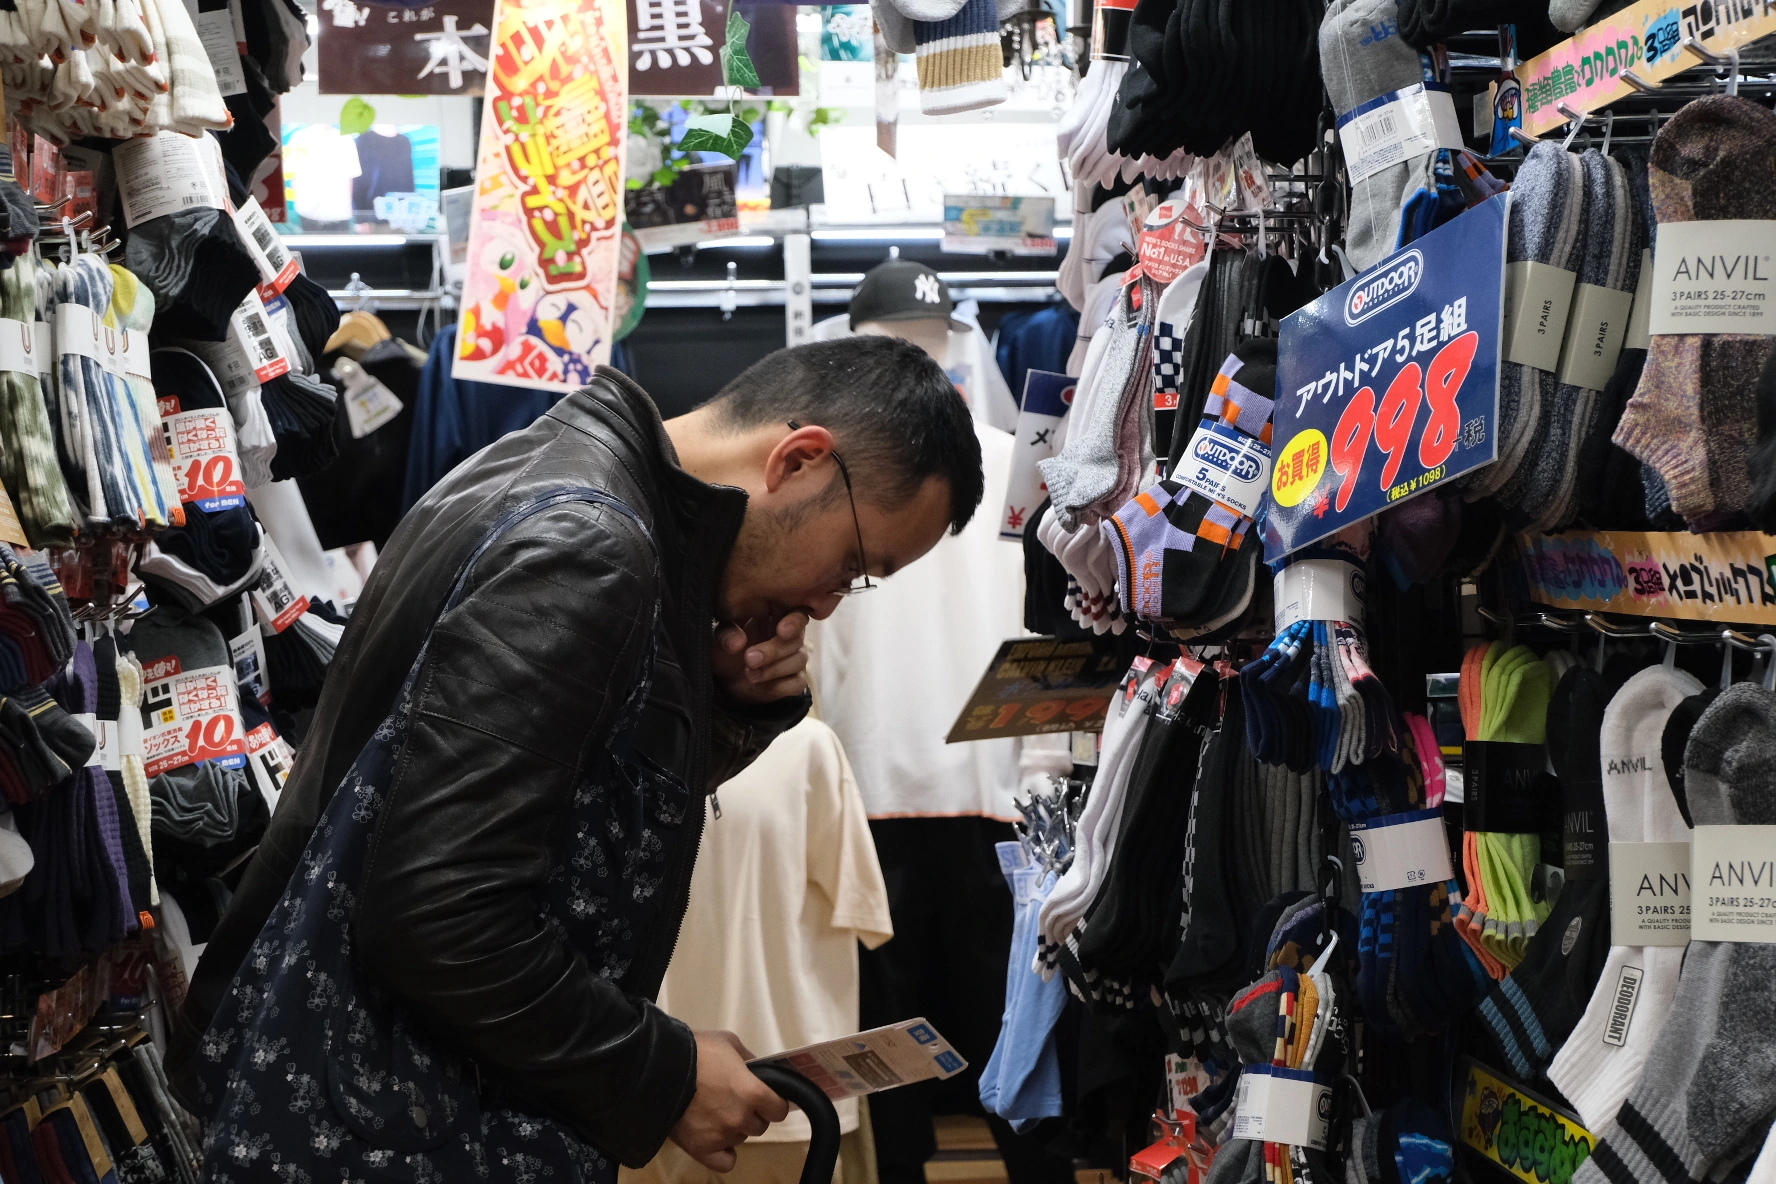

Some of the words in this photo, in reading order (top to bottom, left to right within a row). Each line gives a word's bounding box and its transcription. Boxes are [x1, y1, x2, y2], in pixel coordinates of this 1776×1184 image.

[1144, 236, 1160, 246] MEN'S
[1161, 240, 1178, 250] SOCKS
[1178, 244, 1196, 254] SHARE
[1672, 255, 1768, 281] ANVIL
[1352, 261, 1416, 314] OUTDOOR
[1671, 291, 1678, 301] 3
[1679, 291, 1709, 301] PAIRS
[1712, 290, 1766, 301] 25-27cm
[1539, 300, 1552, 328] PAIRS
[1595, 321, 1609, 349] PAIRS
[1296, 295, 1468, 418] アウトドア5足組
[1197, 440, 1256, 479] OUTDOOR
[1276, 443, 1321, 485] お買得
[184, 455, 233, 494] 10
[1227, 497, 1247, 510] SOCKS
[185, 714, 235, 756] 10
[1607, 756, 1653, 775] ANVIL
[1709, 861, 1774, 887] ANVI
[1637, 906, 1643, 915] 3
[1646, 906, 1675, 915] PAIRS
[1709, 897, 1714, 907] 3
[1715, 897, 1740, 907] PAIRS
[1743, 897, 1776, 908] 25-27c
[1608, 976, 1637, 1042] DEODORANT
